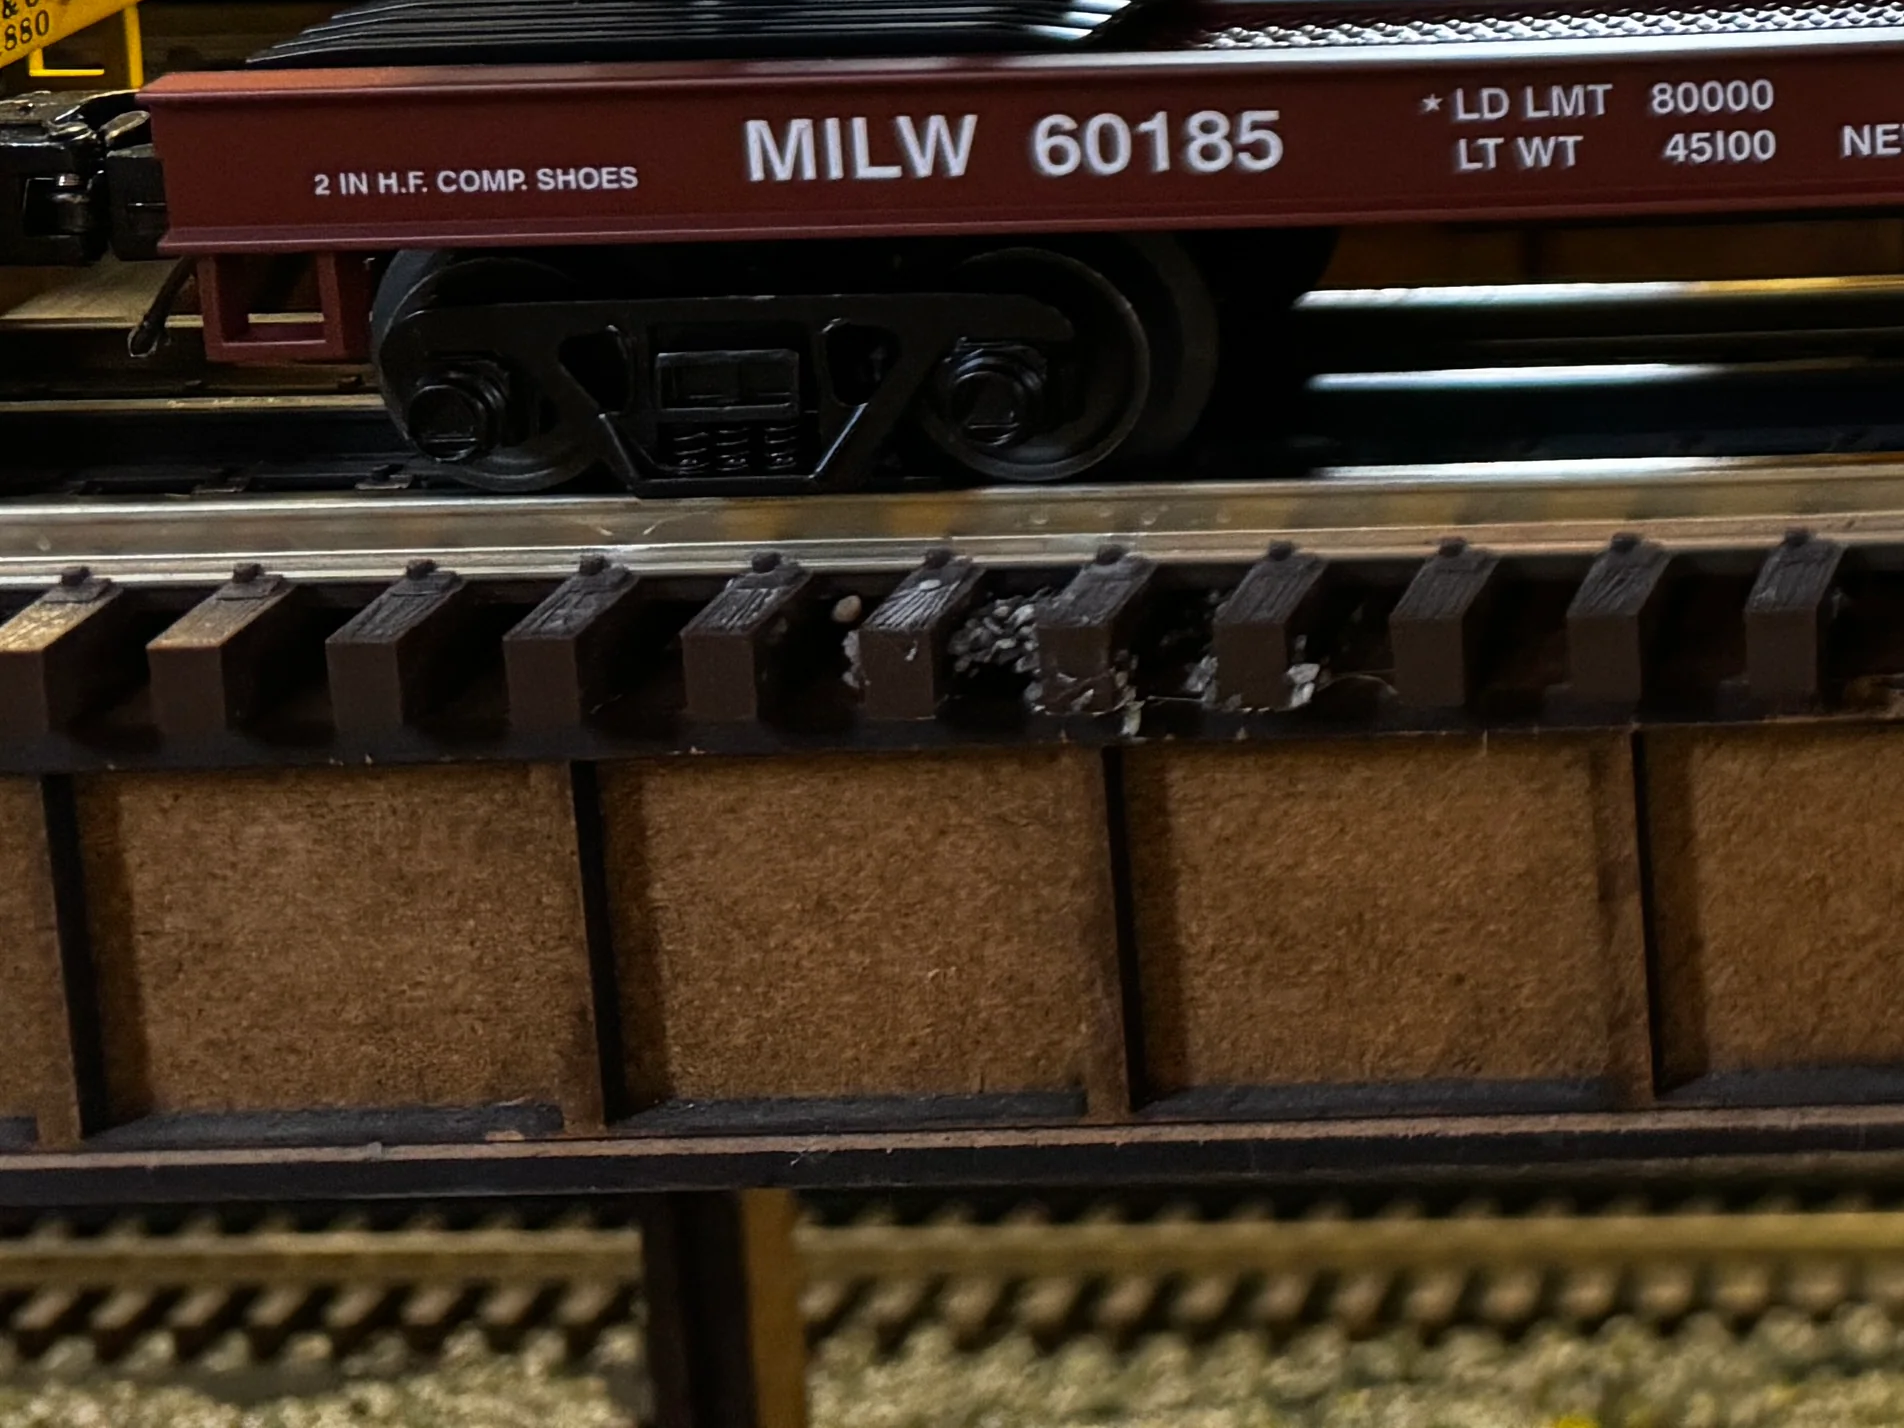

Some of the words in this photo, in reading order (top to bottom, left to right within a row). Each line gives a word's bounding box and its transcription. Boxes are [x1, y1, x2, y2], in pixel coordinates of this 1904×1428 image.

[0, 9, 50, 55] 880
[1455, 87, 1511, 121] LD
[1525, 83, 1613, 120] LMT
[1650, 79, 1775, 114] 80000
[745, 114, 978, 182] MILW
[1033, 110, 1283, 177] 60185
[1457, 136, 1504, 171] LT
[1517, 135, 1585, 169] WT
[313, 173, 331, 195] 2
[339, 172, 369, 195] IN
[437, 168, 528, 193] COMP.
[536, 166, 639, 191] SHOES
